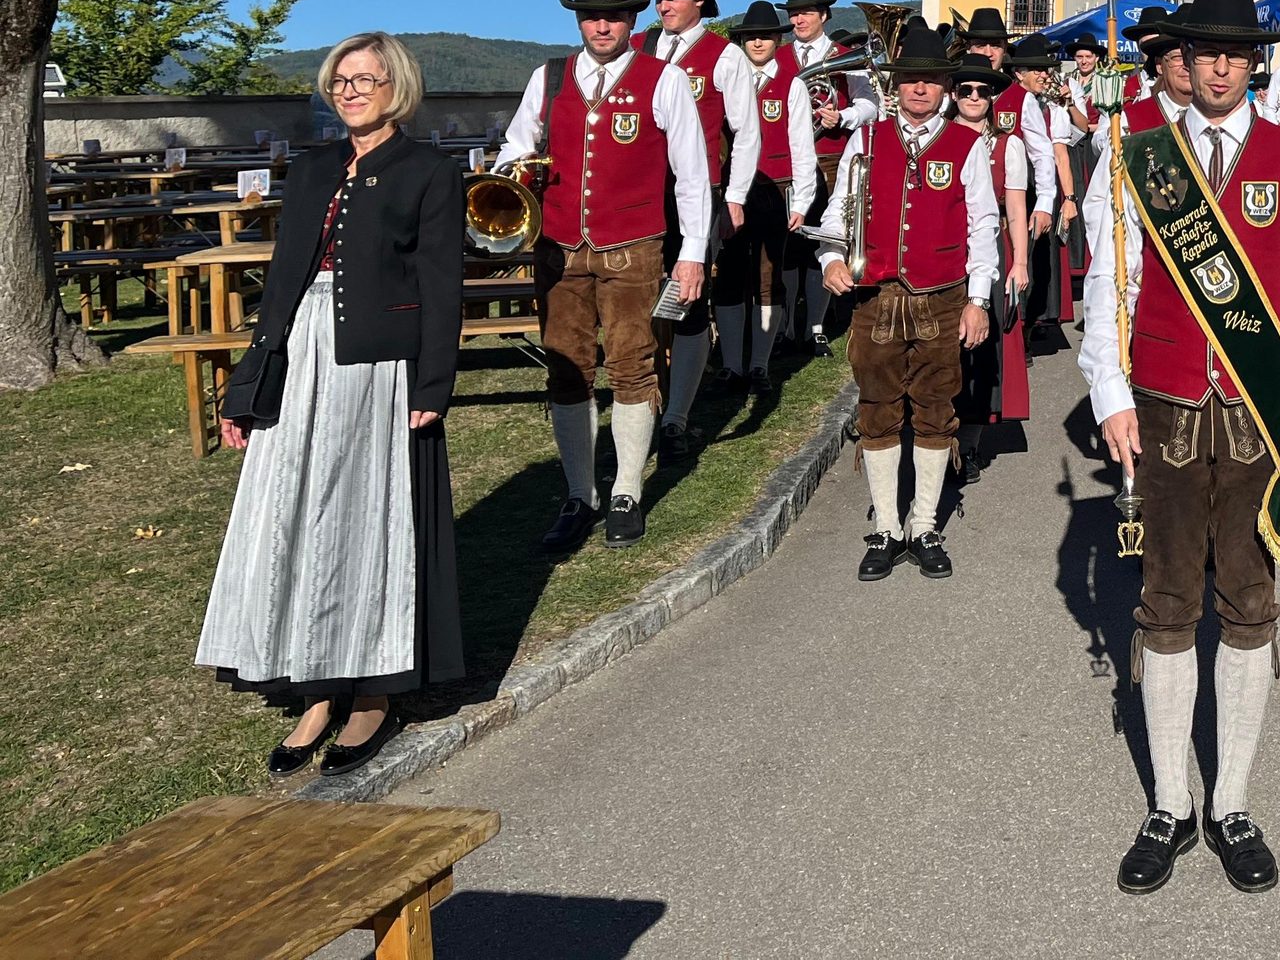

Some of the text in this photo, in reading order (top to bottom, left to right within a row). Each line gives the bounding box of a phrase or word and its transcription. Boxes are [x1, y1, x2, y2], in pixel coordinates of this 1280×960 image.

[1159, 199, 1209, 240] Kamerad-
[1173, 220, 1212, 249] schafts-
[1181, 232, 1218, 263] kapelle
[1222, 309, 1263, 334] Weiz
